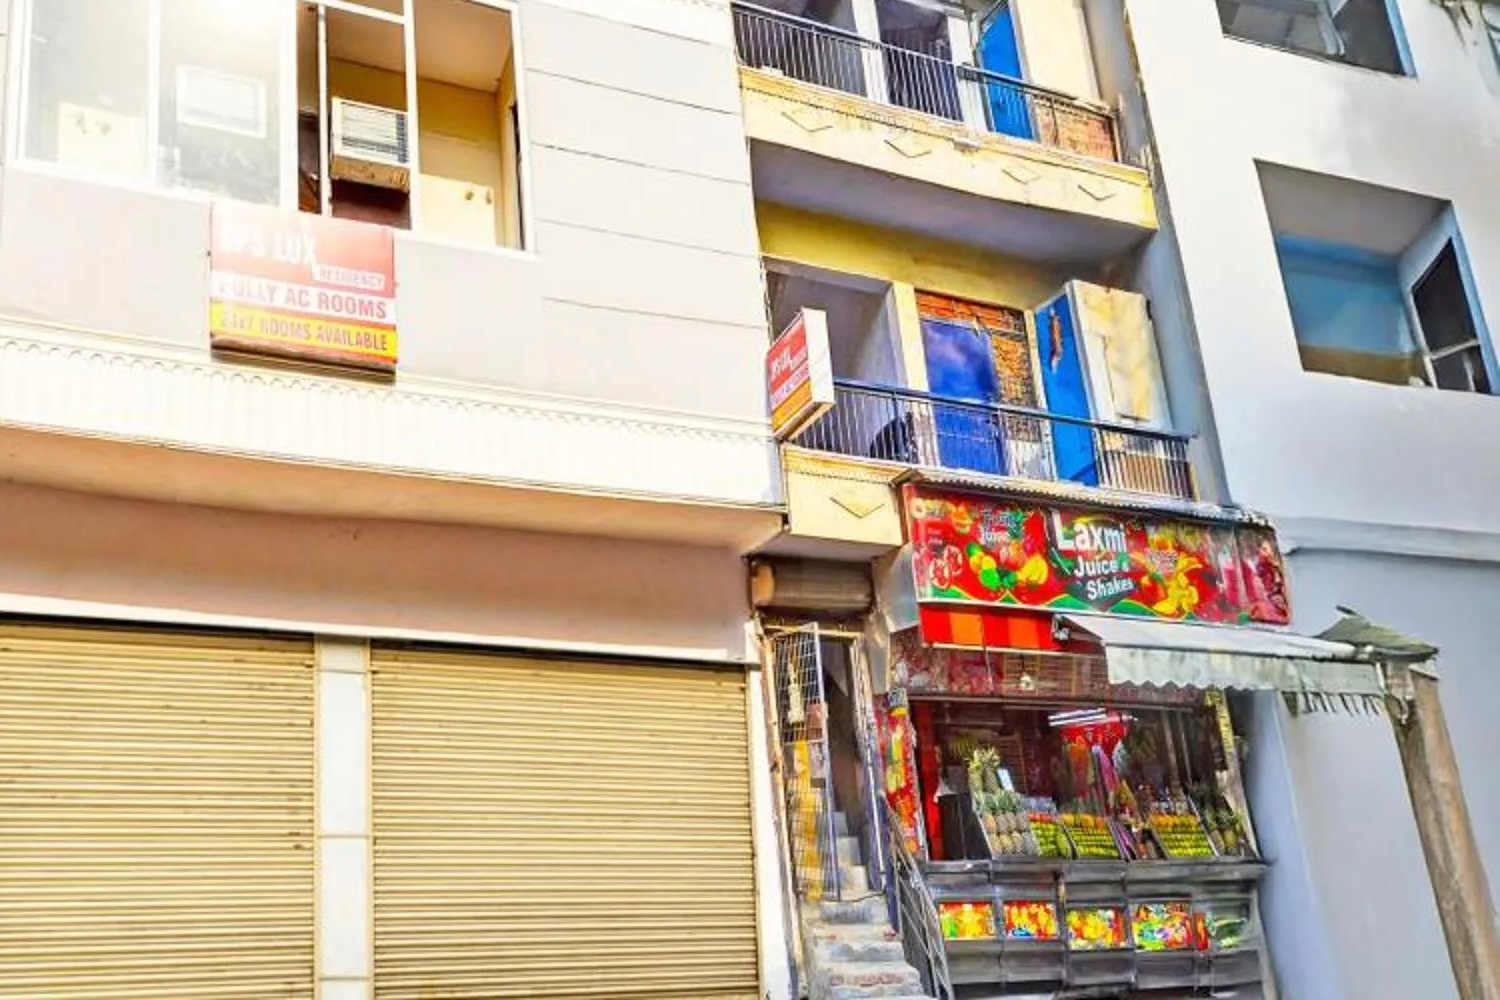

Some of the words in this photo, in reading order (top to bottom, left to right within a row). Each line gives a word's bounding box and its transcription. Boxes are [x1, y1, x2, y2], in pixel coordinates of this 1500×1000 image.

[285, 287, 311, 308] AC
[317, 291, 387, 319] ROOMS
[316, 325, 389, 351] AVAILABLE
[1052, 509, 1127, 552] Laxmi
[1074, 555, 1119, 577] Juice
[1086, 577, 1134, 600] Shakes
